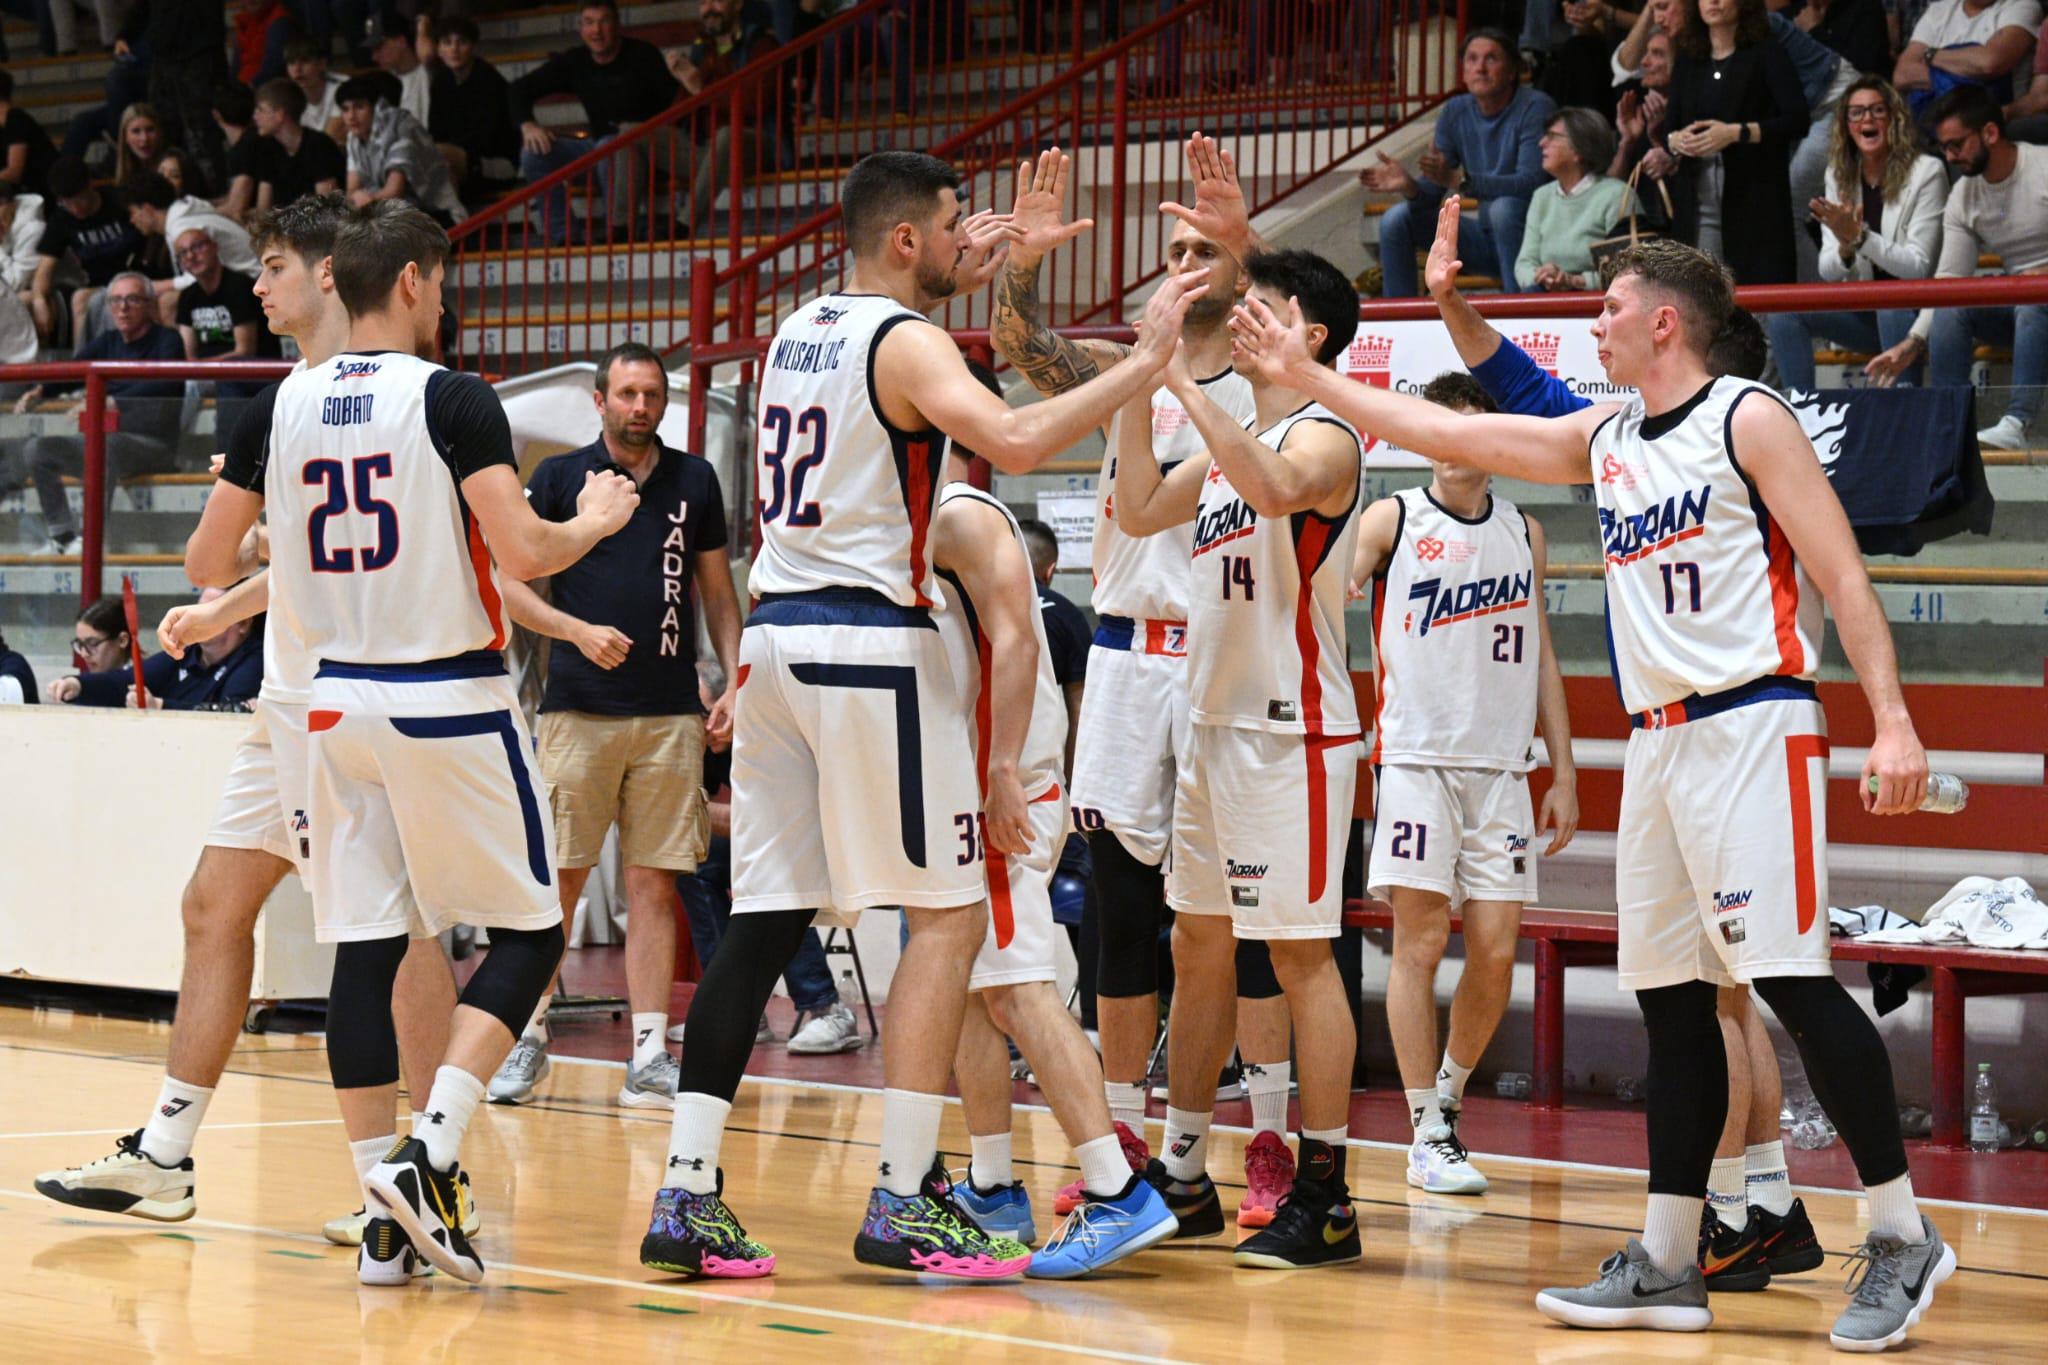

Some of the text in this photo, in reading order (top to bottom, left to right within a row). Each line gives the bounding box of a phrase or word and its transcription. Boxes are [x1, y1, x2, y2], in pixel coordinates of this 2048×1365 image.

[322, 393, 374, 426] GOBATO
[760, 404, 828, 527] 32
[302, 452, 400, 573] 25
[659, 500, 688, 657] JADRAN
[1222, 555, 1256, 602] 14
[1408, 569, 1532, 637] JADRAN
[1659, 561, 1702, 614] 17
[1909, 591, 1944, 622] 40
[1492, 623, 1524, 664] 21
[1391, 820, 1427, 861] 21
